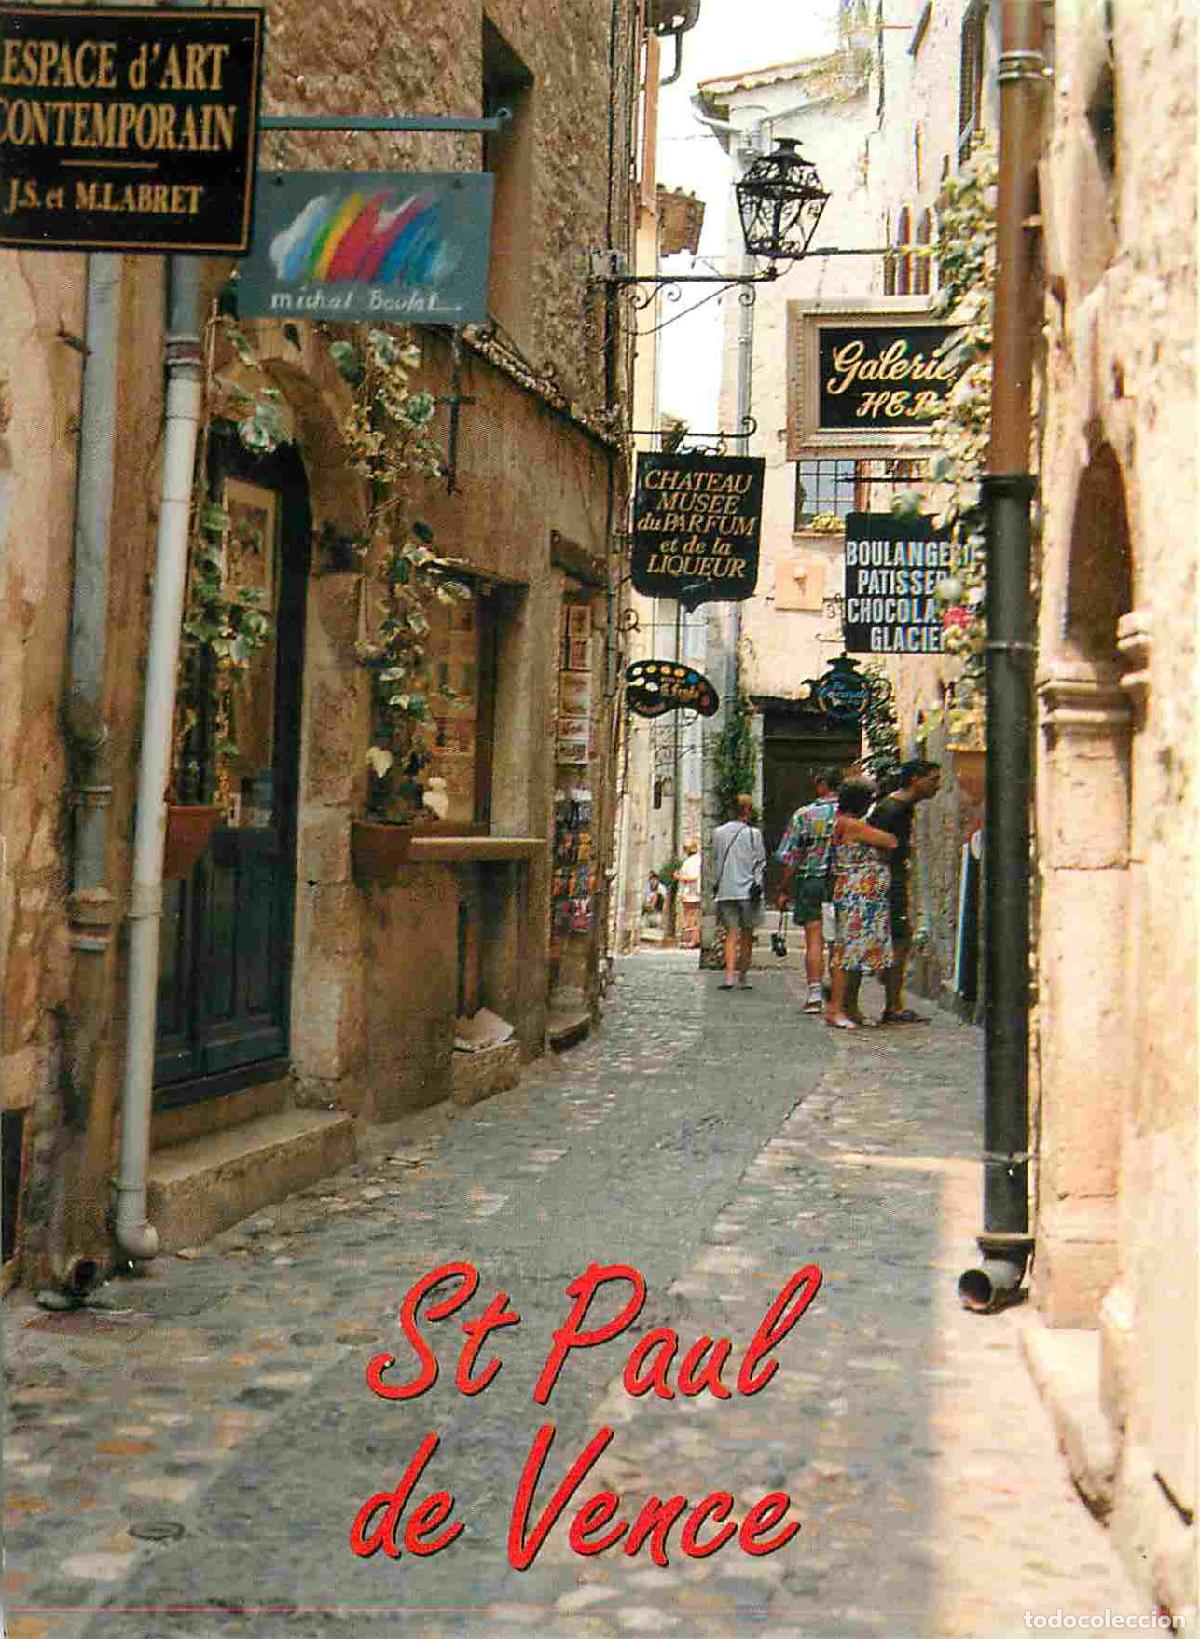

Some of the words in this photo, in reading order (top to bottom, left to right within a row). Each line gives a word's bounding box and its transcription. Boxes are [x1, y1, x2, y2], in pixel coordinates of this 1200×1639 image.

[1, 38, 117, 88] ESPACE
[128, 42, 230, 90] d'ART
[46, 185, 63, 209] et
[645, 469, 752, 494] CHATEAU
[656, 491, 741, 515] MUSEE
[639, 512, 660, 531] du
[662, 512, 759, 536] PARFUM
[659, 538, 678, 553] et
[682, 535, 705, 554] de
[712, 536, 732, 556] la
[646, 554, 747, 578] LIQUEUR
